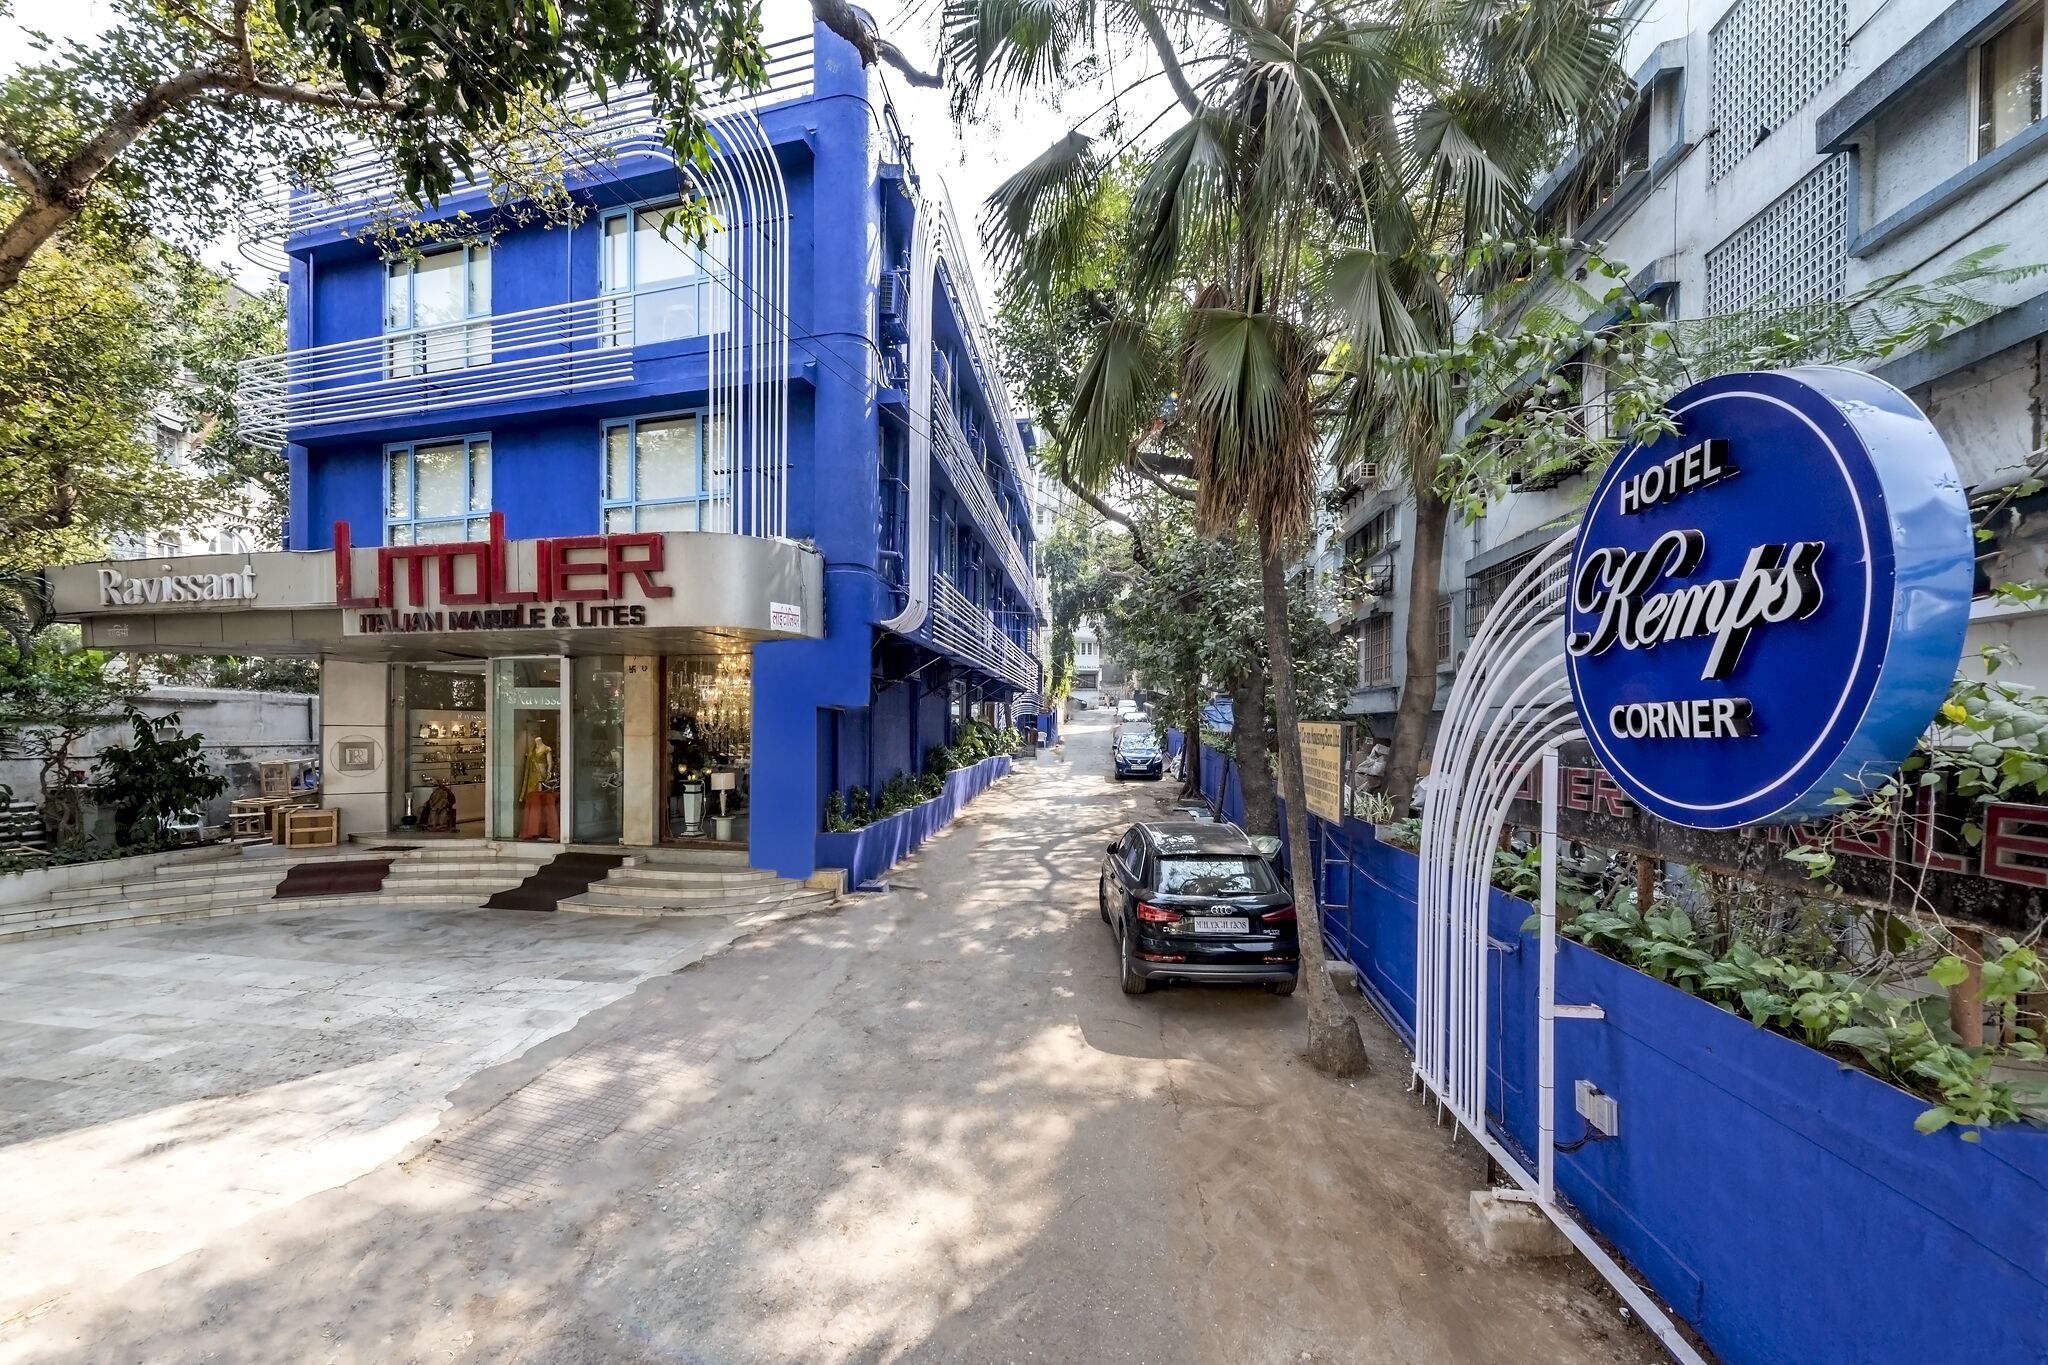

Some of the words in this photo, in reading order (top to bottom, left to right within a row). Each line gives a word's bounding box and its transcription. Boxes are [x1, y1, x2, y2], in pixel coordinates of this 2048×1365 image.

[1620, 438, 1730, 515] HOTEL
[333, 511, 673, 609] LITOLIER
[96, 564, 257, 606] Ravissant
[359, 609, 443, 633] ITALIAN
[448, 604, 546, 630] MARBLE
[551, 606, 571, 627] &
[576, 602, 646, 626] LITES
[1609, 697, 1748, 739] CORNER
